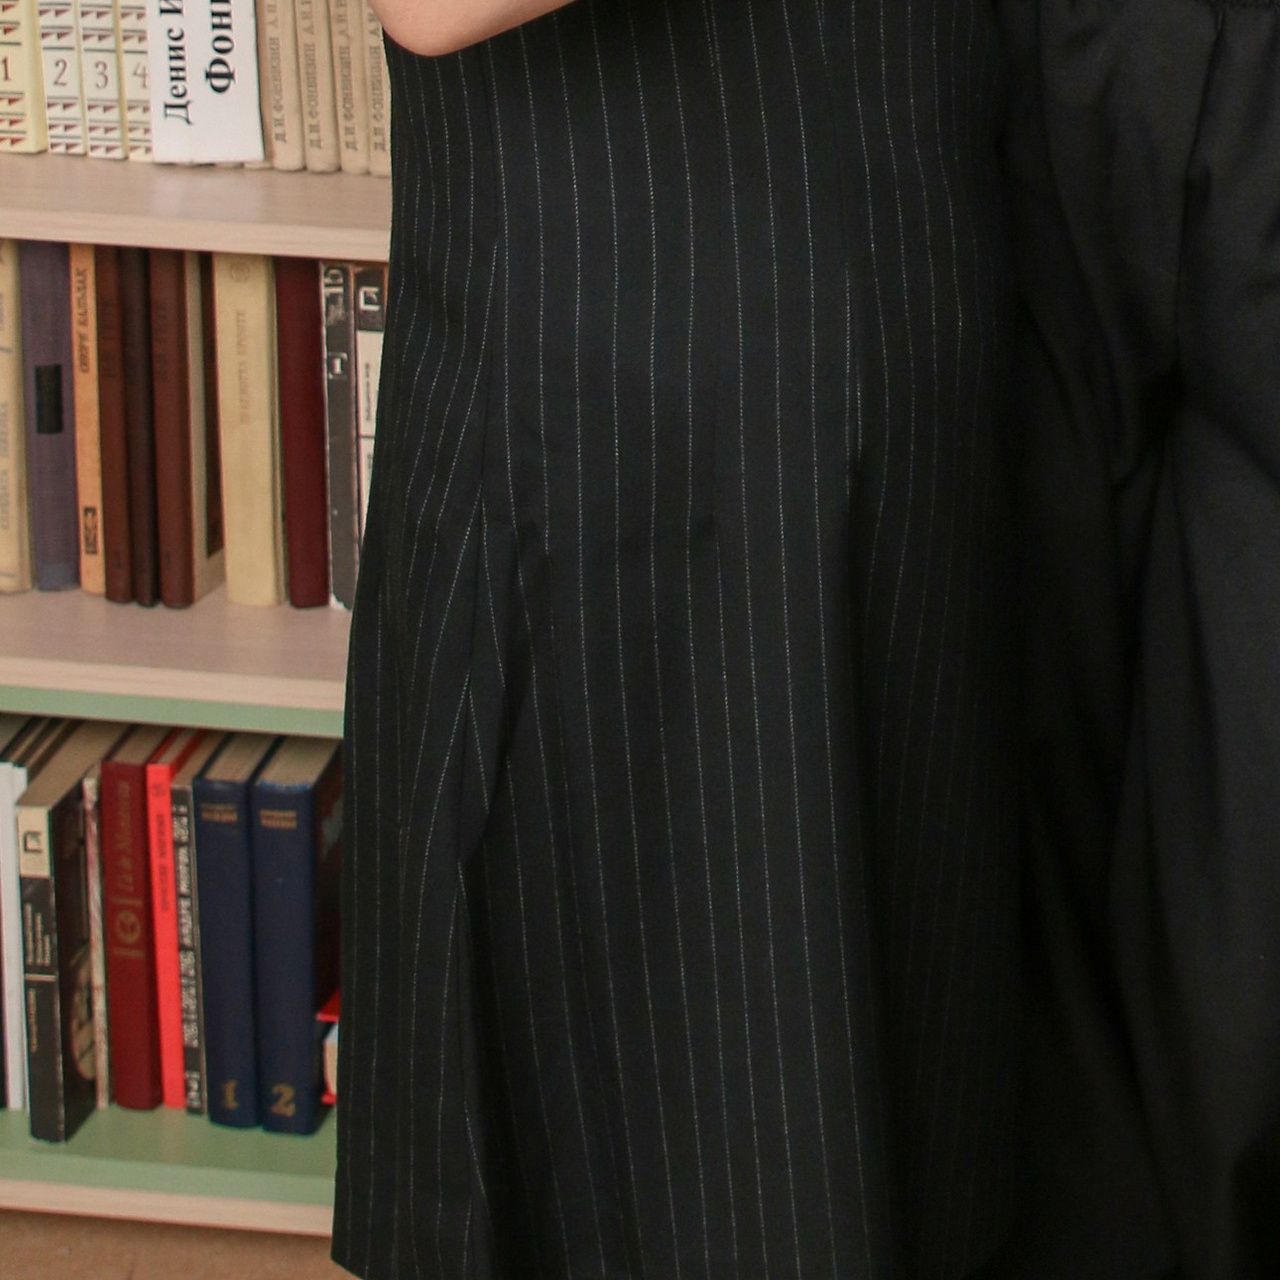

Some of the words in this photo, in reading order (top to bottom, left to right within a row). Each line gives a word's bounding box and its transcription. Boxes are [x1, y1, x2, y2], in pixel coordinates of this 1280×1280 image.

[1, 59, 11, 82] 1
[53, 60, 68, 86] 2
[94, 61, 108, 88] 3
[163, 28, 194, 125] Денис
[221, 1079, 239, 1110] 1
[272, 1084, 295, 1117] 2
